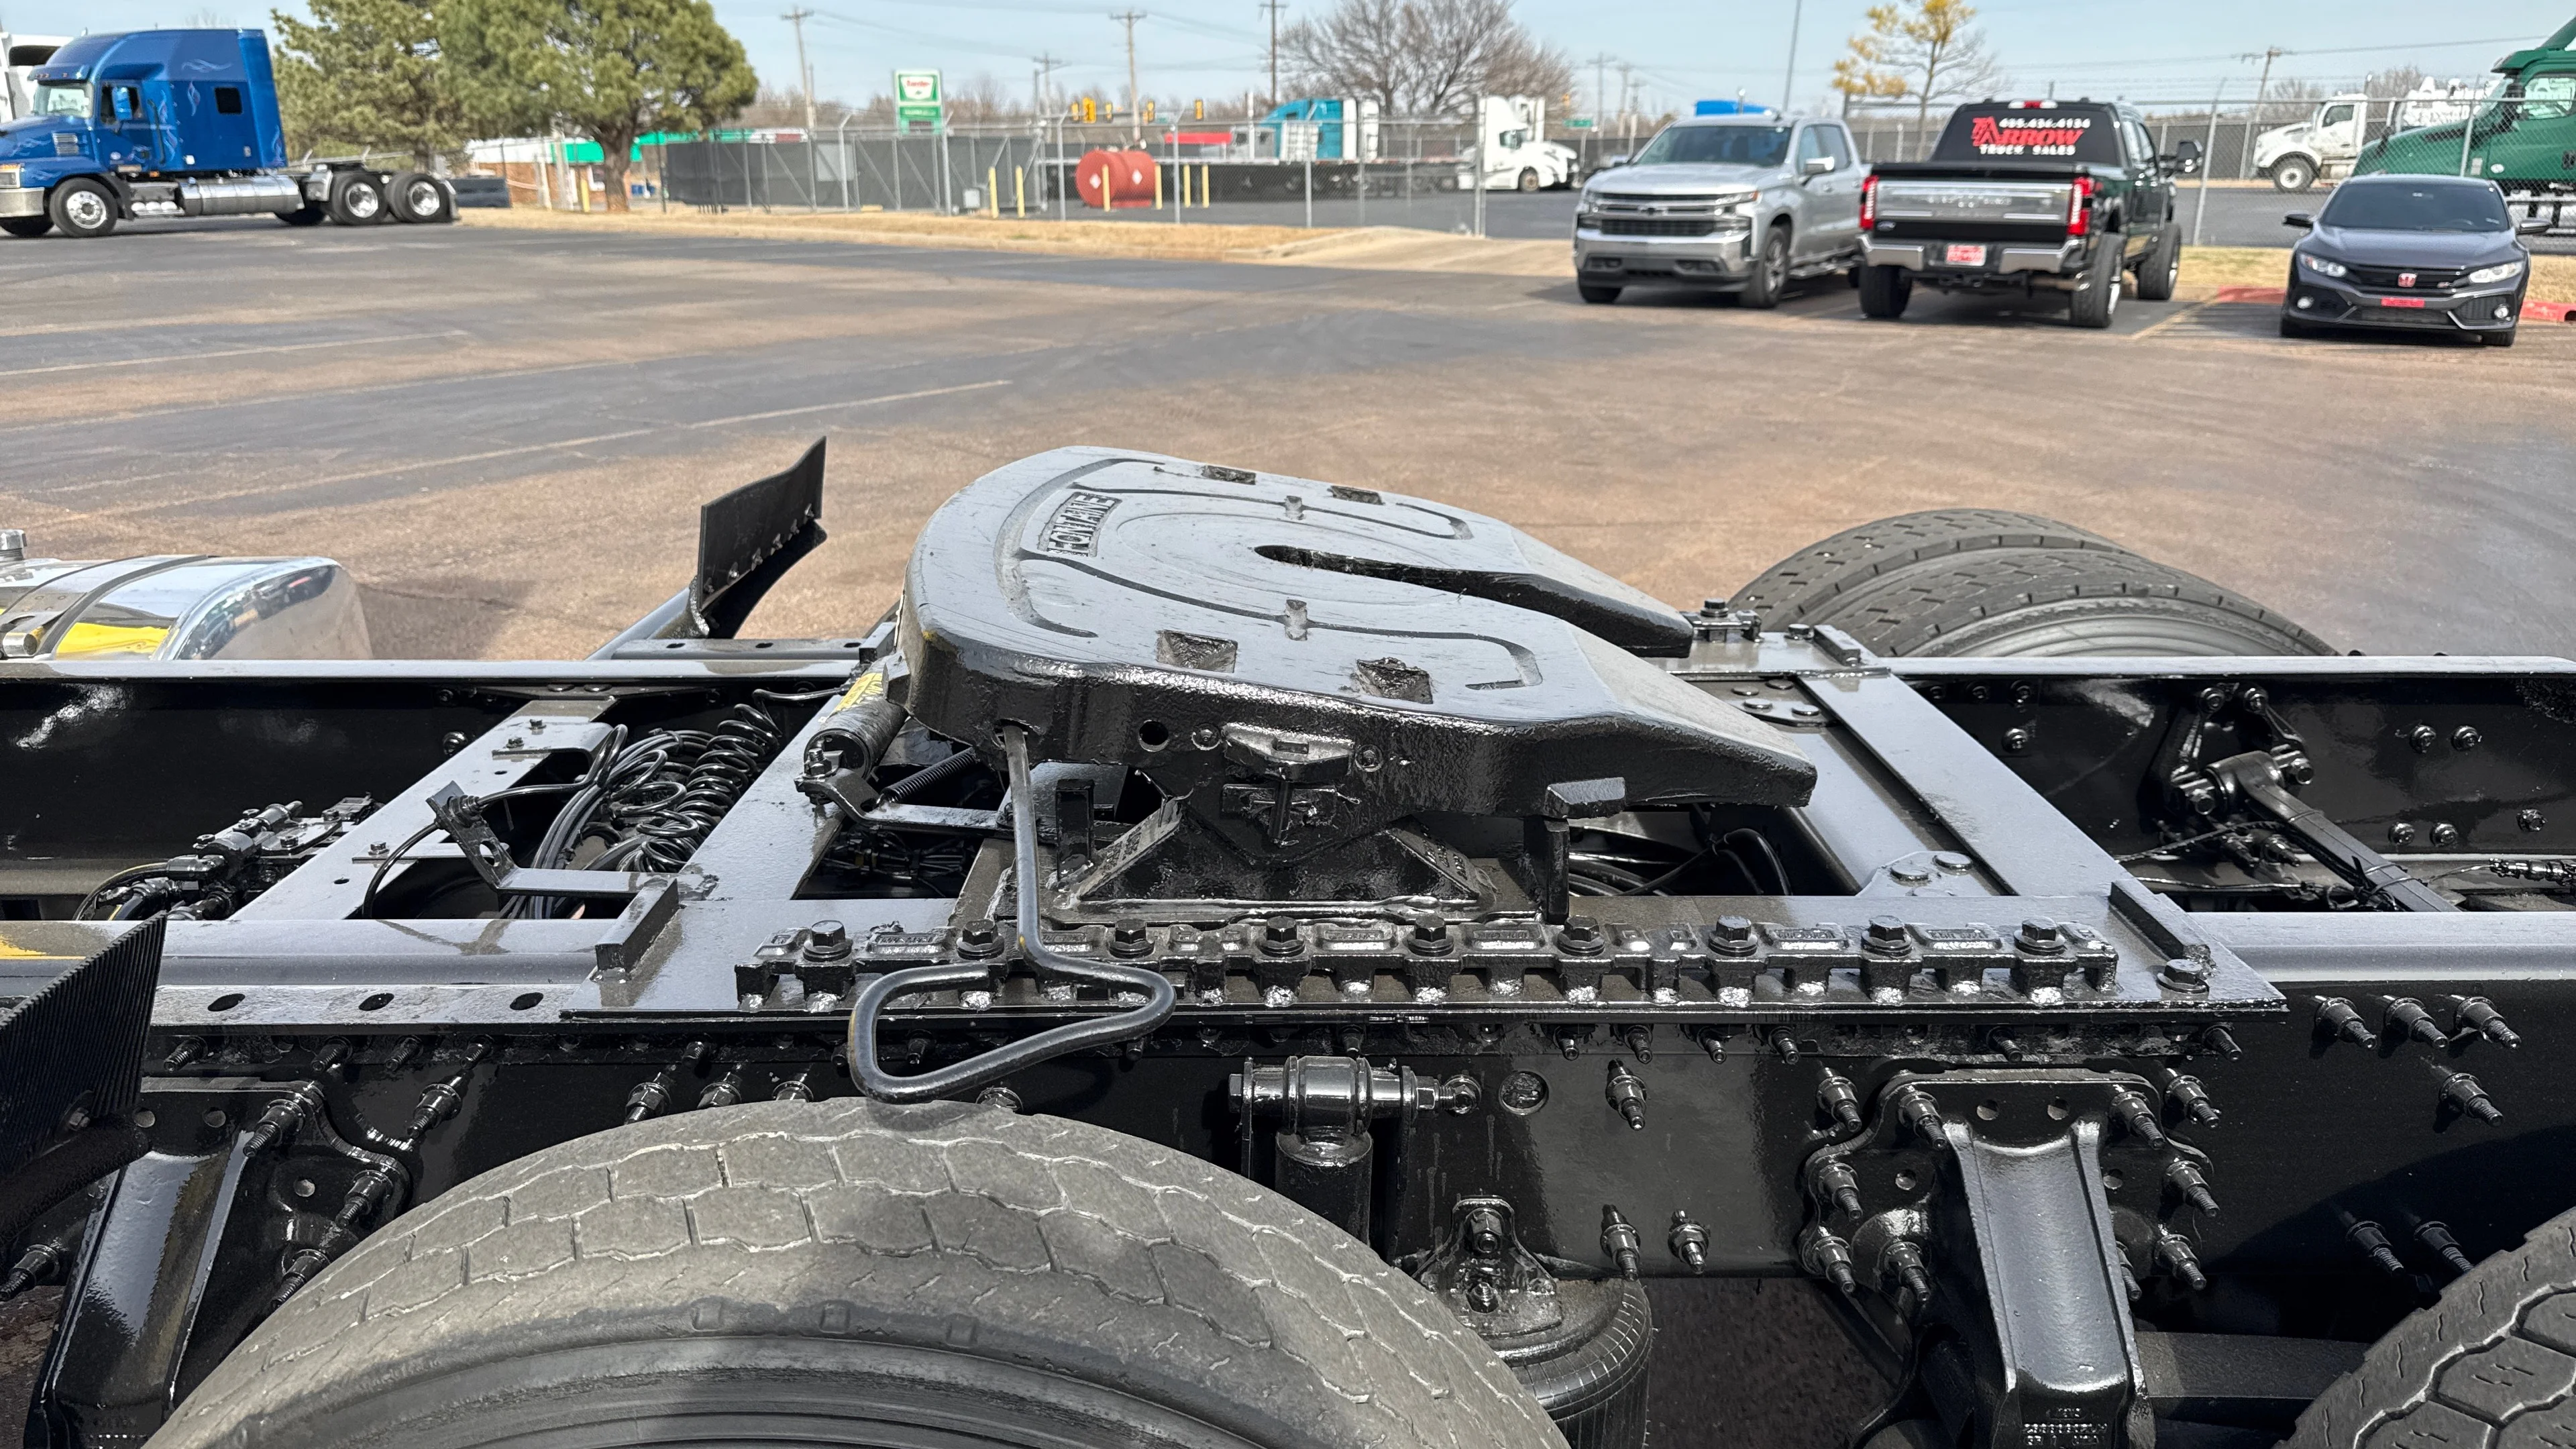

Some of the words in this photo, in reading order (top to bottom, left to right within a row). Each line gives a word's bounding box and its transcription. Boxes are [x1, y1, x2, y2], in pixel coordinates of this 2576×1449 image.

[1980, 144, 2025, 156] TRUCK
[2033, 144, 2076, 156] SALES
[1046, 494, 1115, 554] FONTAINE
